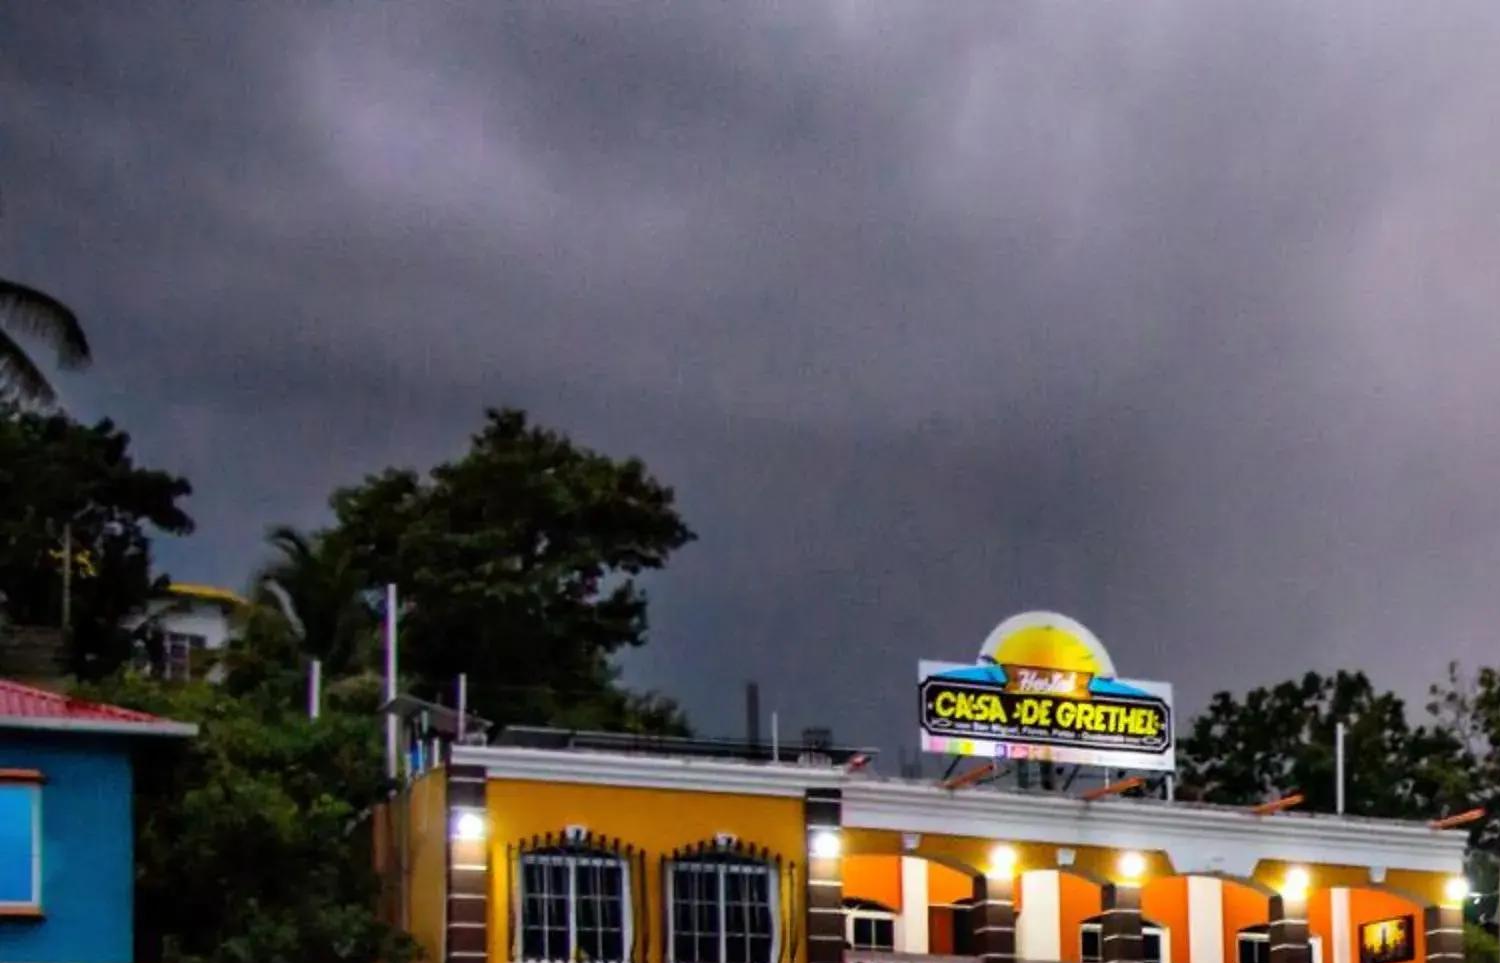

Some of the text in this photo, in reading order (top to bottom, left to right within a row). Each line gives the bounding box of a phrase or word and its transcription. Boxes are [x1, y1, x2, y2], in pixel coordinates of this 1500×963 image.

[935, 690, 1007, 722] CASA
[1020, 698, 1052, 726] DE
[1055, 701, 1159, 736] GRETHEL
